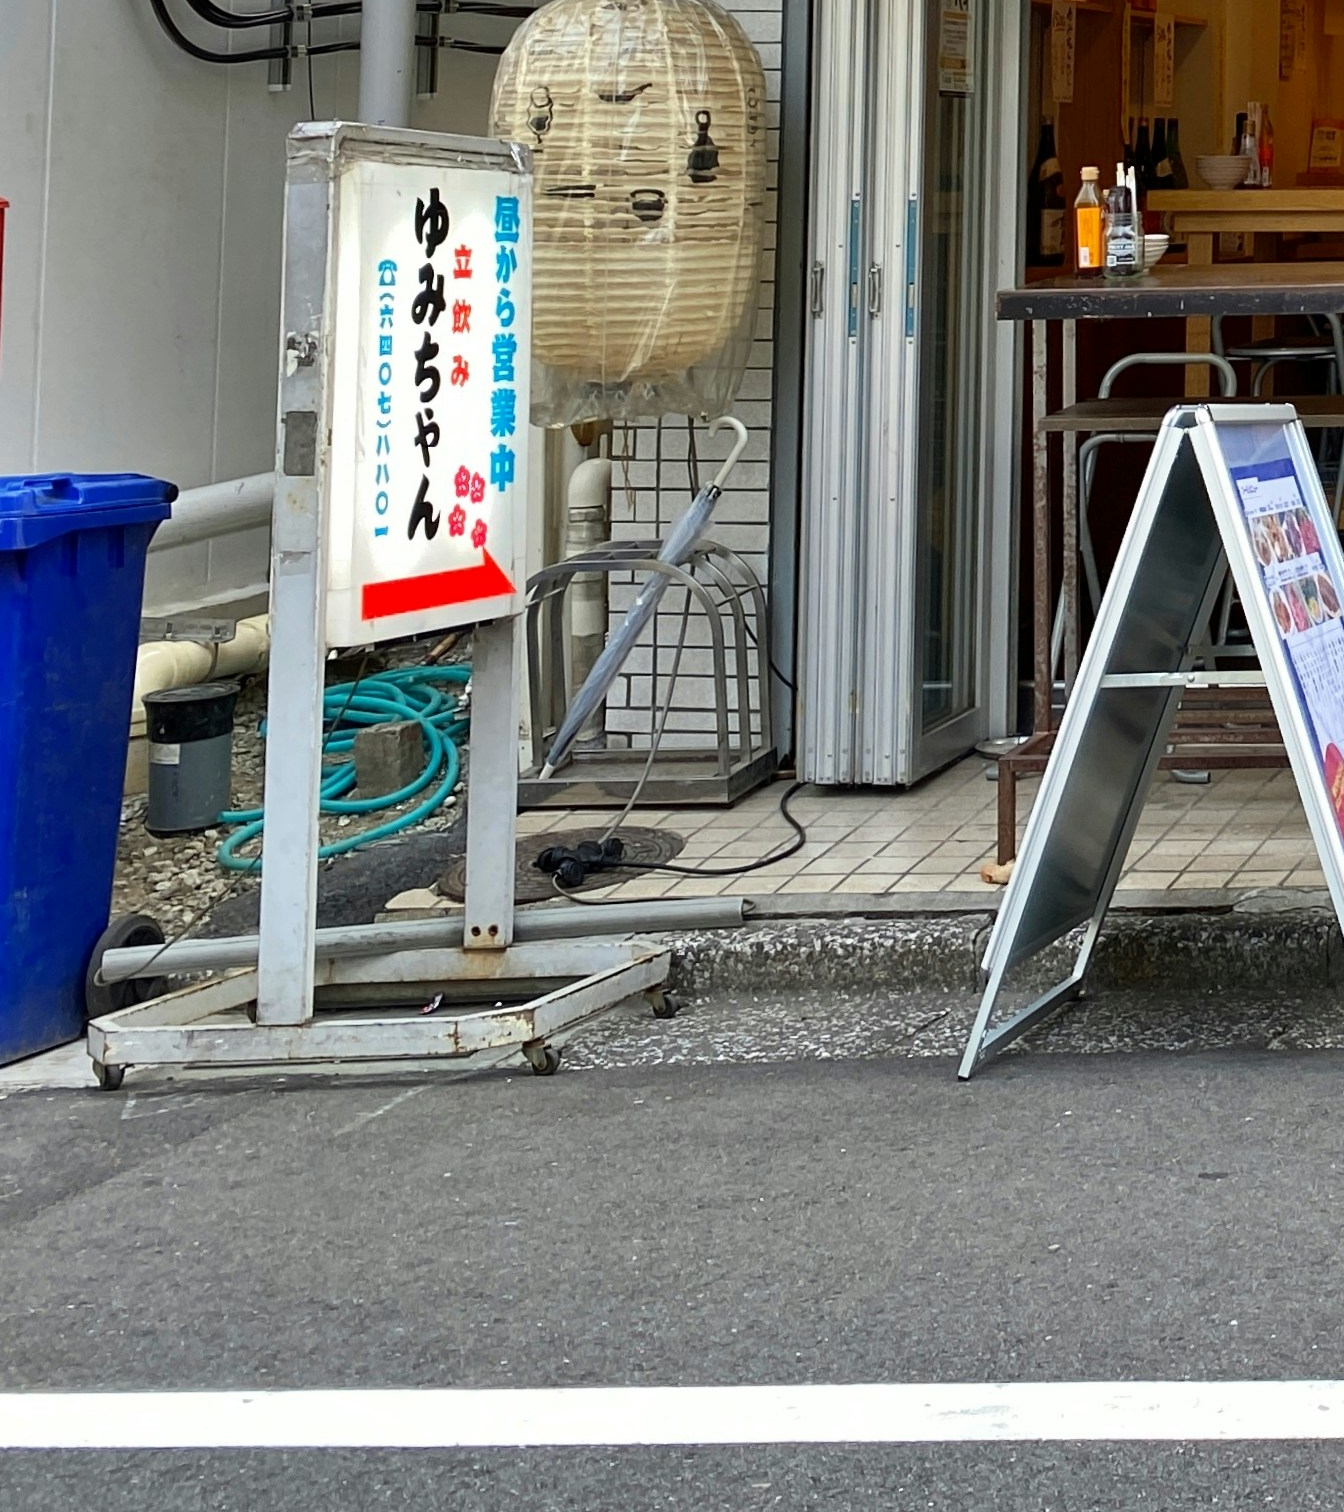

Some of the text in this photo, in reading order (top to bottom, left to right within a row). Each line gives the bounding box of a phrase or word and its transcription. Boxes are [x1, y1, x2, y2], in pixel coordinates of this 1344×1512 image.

[407, 187, 450, 543] ゆみちゃん
[449, 244, 474, 388] 立飲み
[489, 195, 521, 493] 昼から営業中
